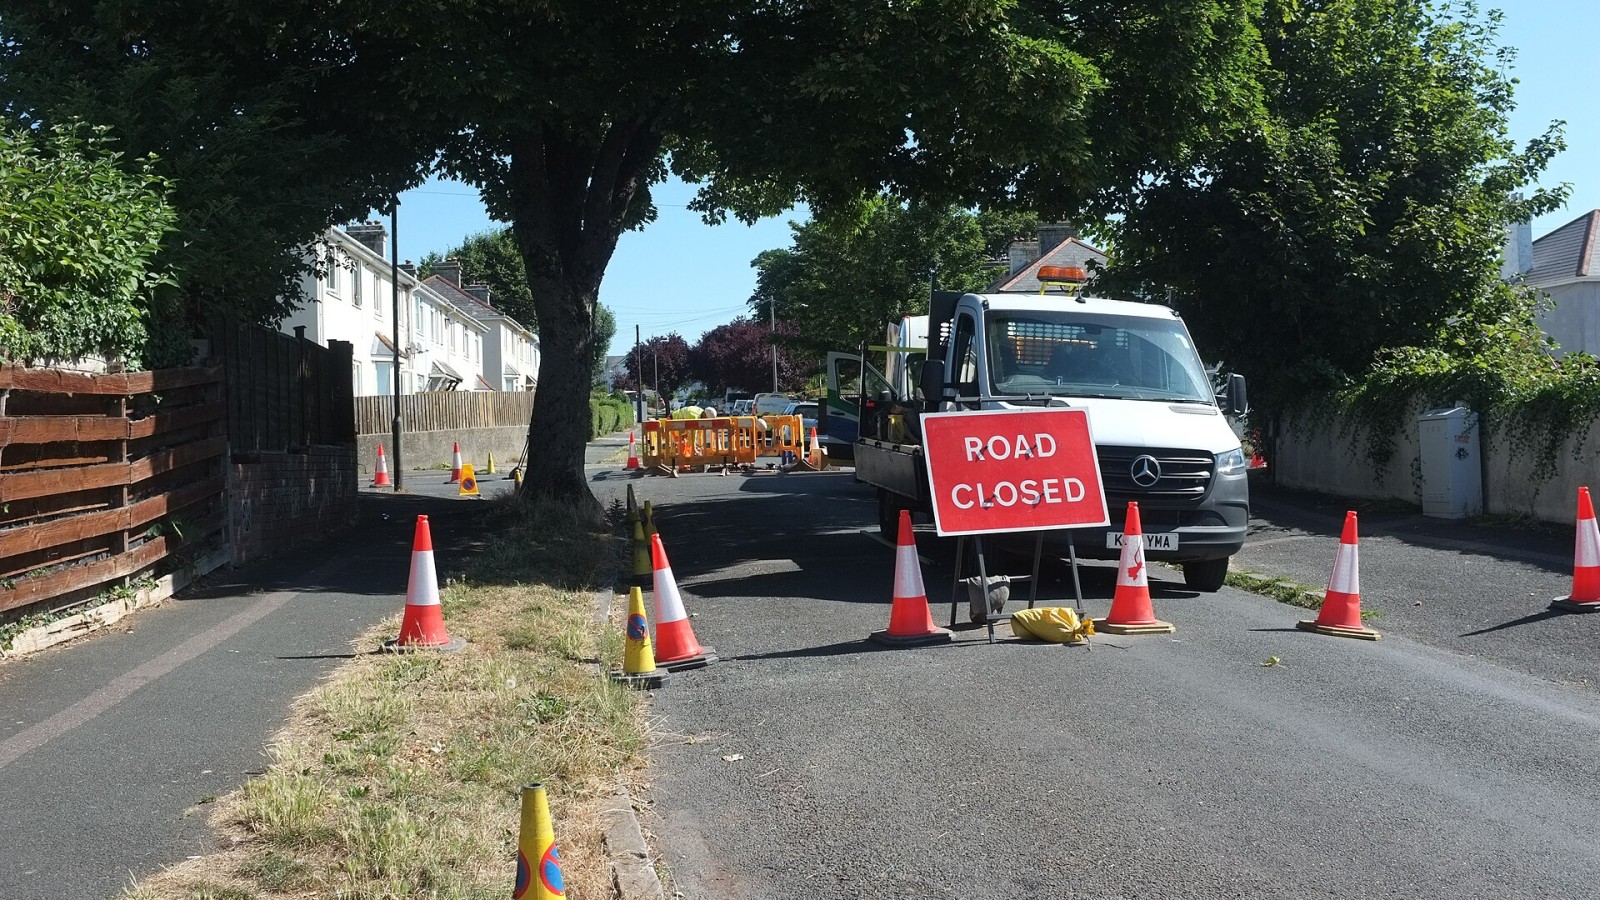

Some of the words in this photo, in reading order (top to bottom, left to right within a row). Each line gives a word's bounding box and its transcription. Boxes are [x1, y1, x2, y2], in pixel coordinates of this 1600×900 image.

[964, 433, 1057, 462] ROAD
[951, 477, 1086, 510] CLOSED
[1147, 535, 1170, 548] YMA
